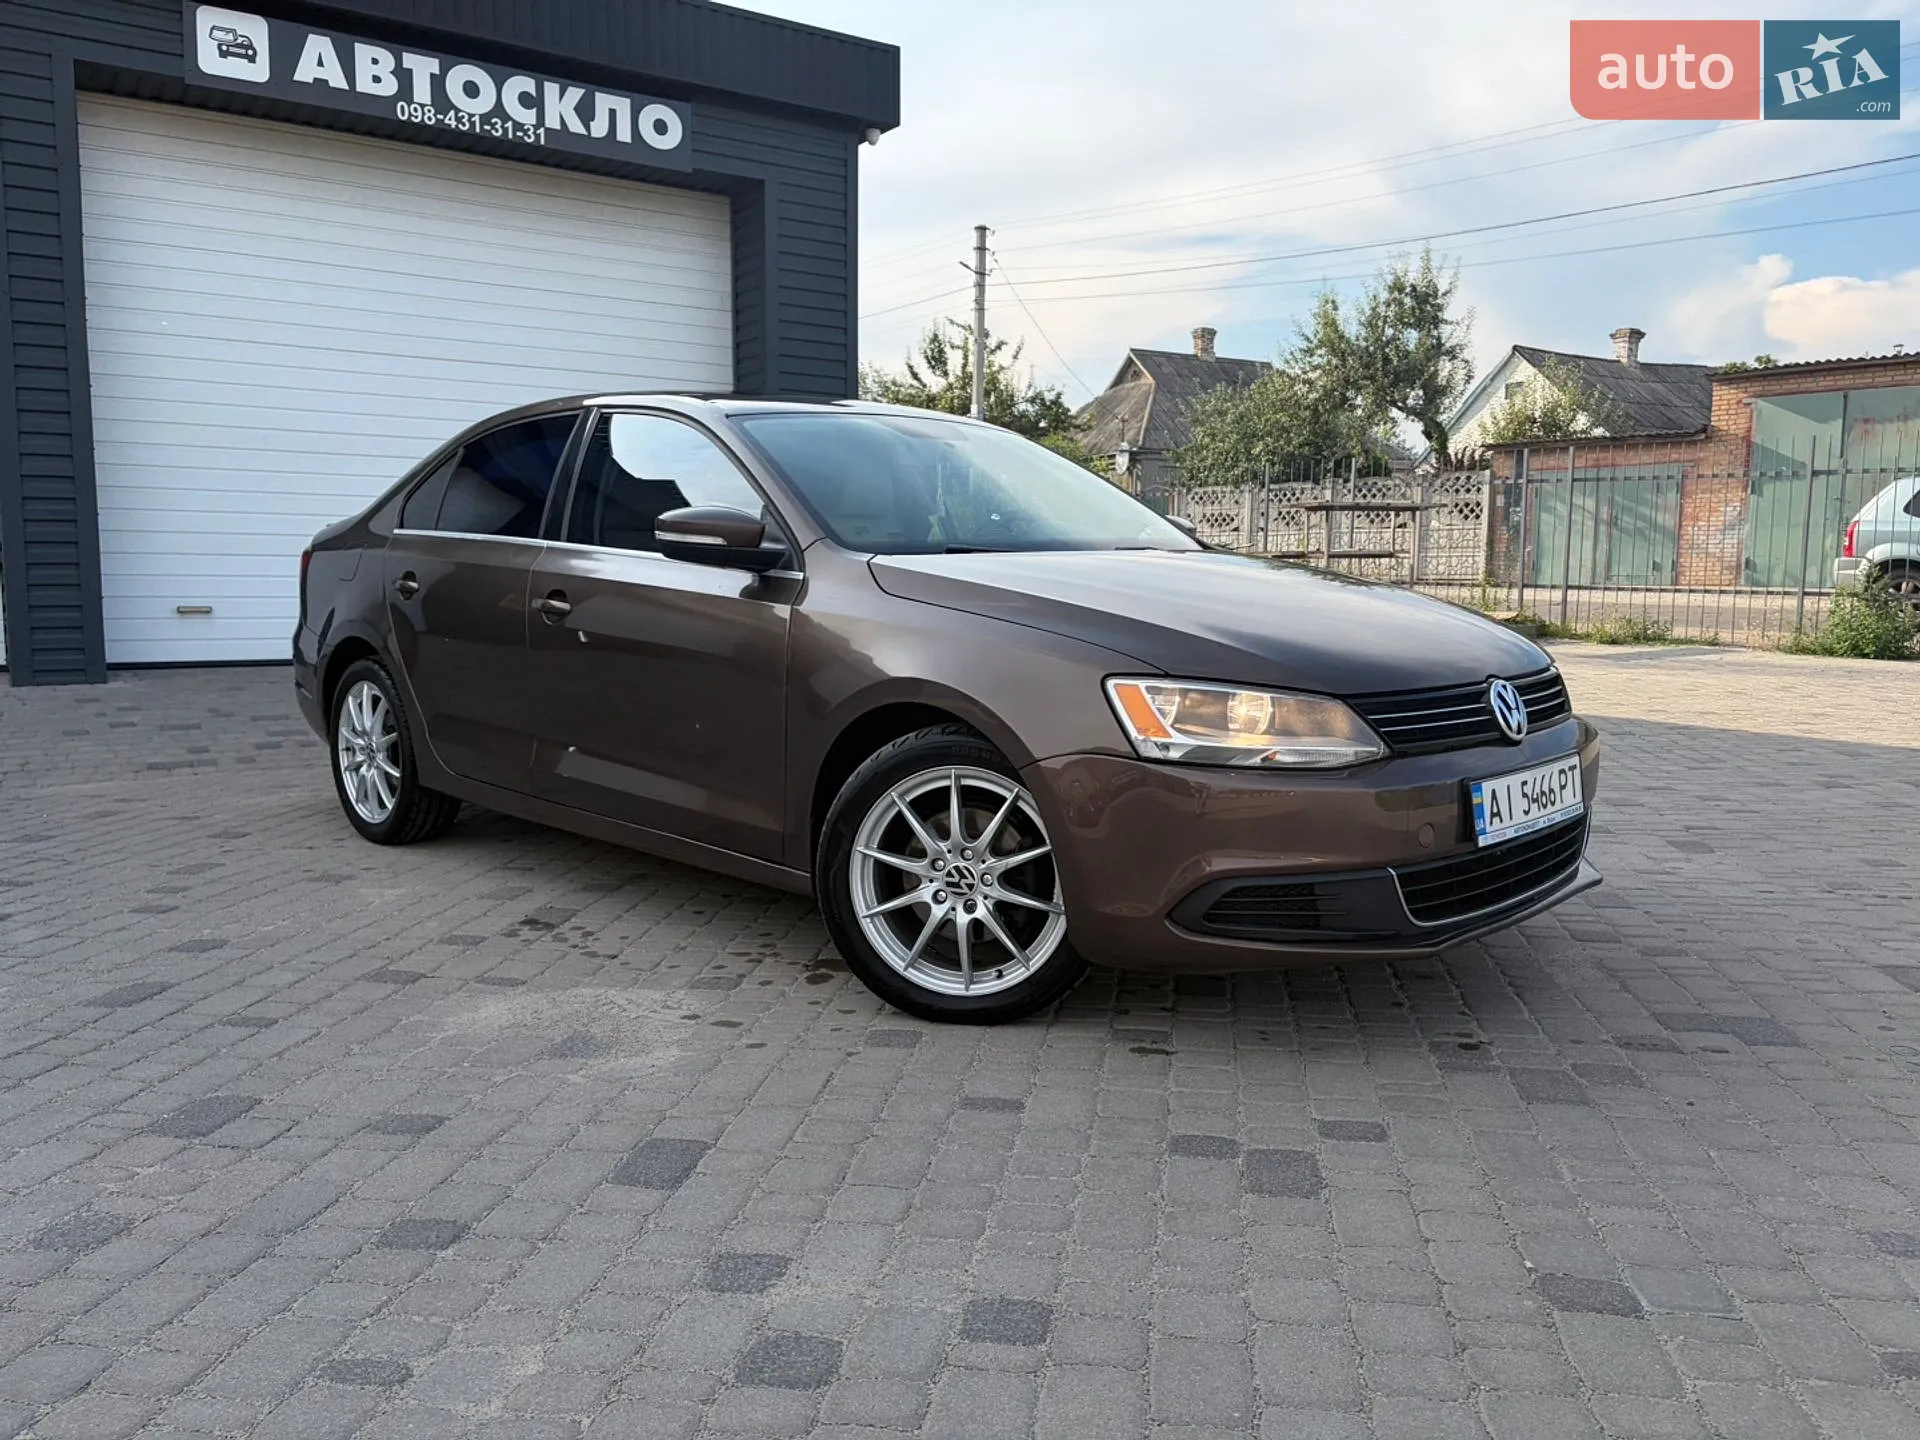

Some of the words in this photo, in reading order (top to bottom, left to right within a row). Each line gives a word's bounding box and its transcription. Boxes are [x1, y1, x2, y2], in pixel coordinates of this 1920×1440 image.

[293, 33, 683, 150] АВТОСКЛО
[396, 101, 547, 146] 098-431-31-31
[1489, 784, 1513, 826] AI
[1521, 771, 1556, 816] 5466
[1558, 764, 1577, 804] PT
